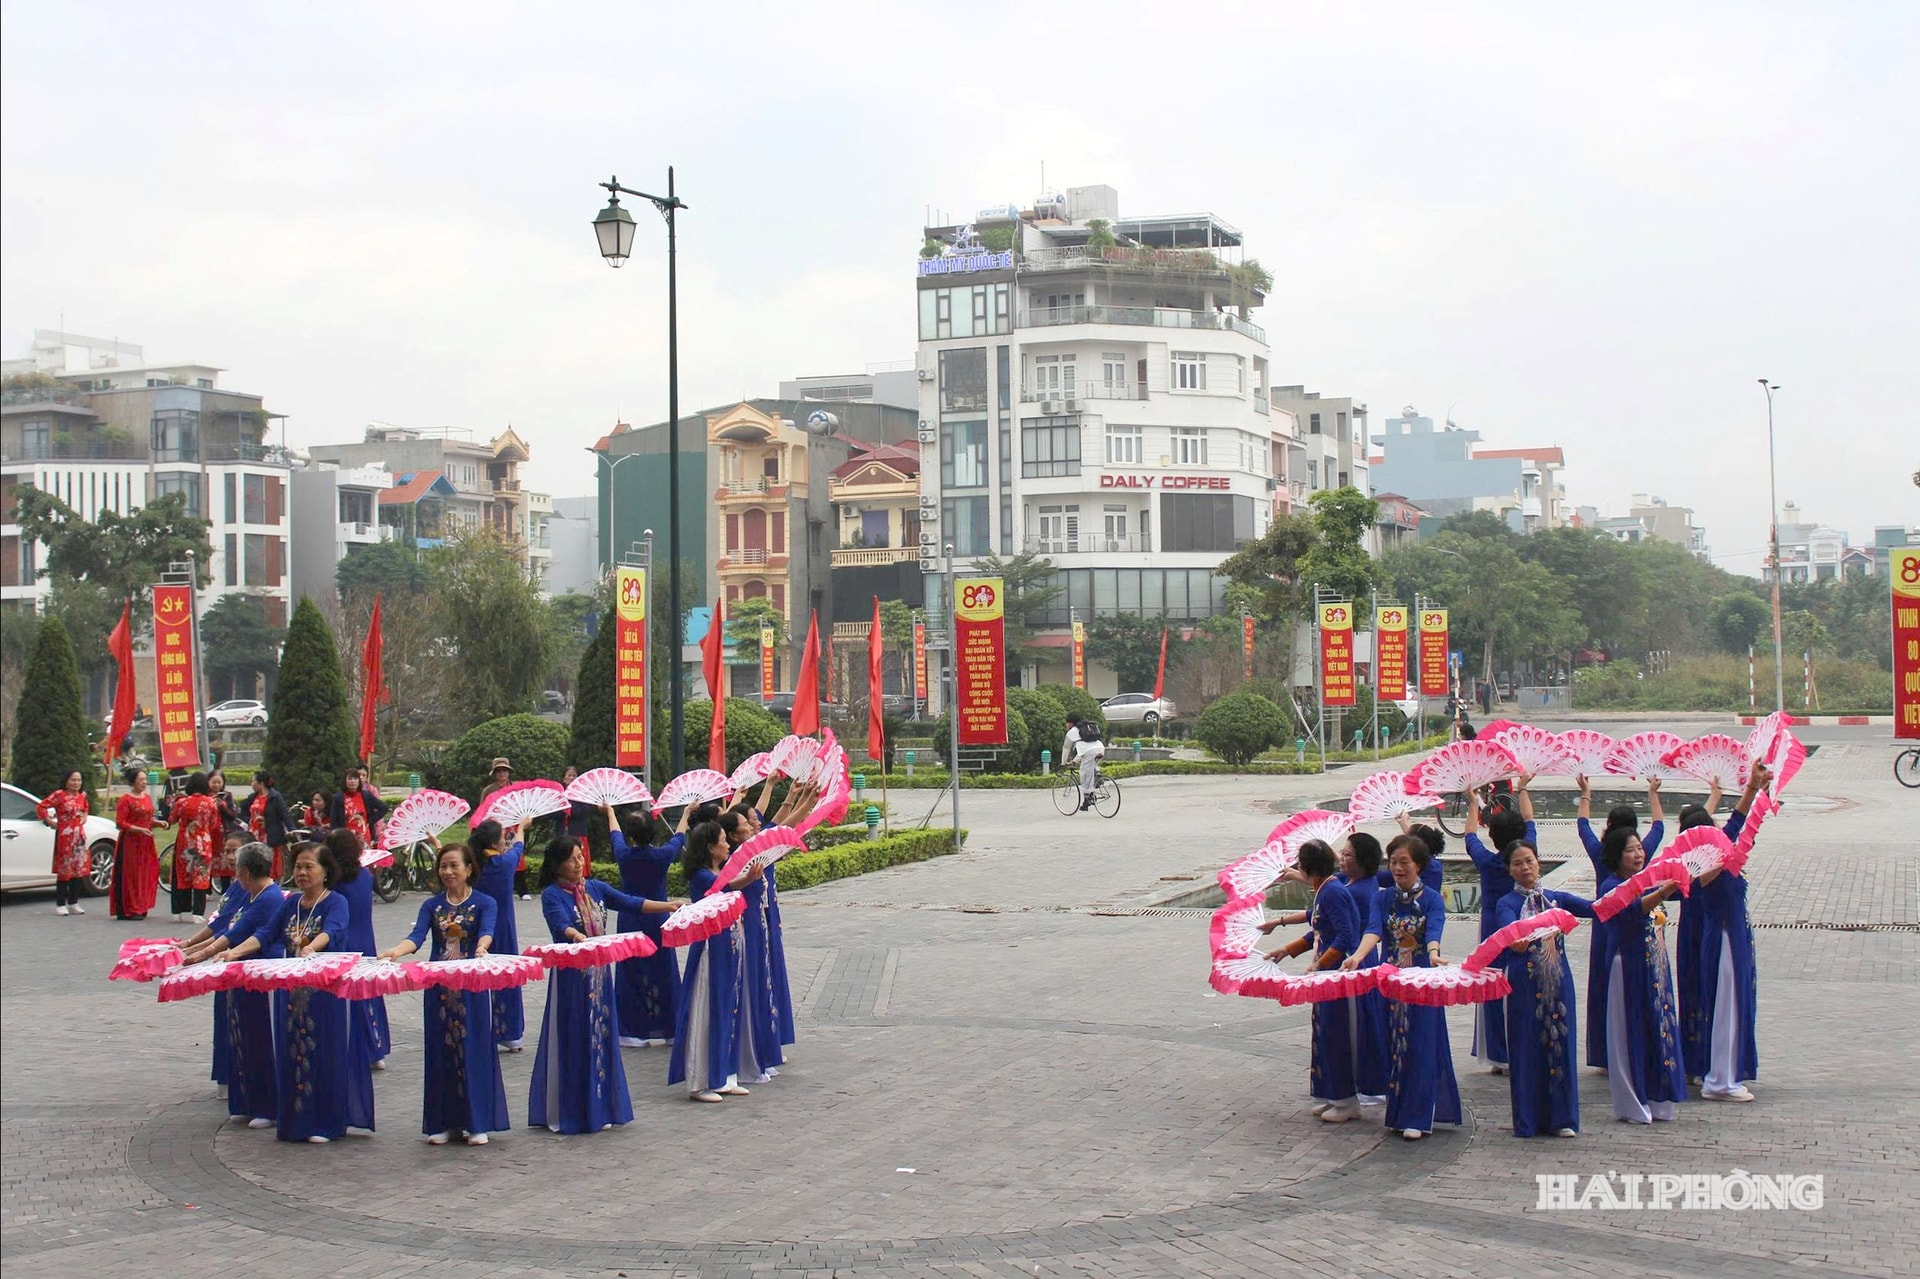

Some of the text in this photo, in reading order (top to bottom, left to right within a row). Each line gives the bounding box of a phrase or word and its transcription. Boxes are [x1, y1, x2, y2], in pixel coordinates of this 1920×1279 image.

[968, 249, 996, 272] QUỐC
[999, 248, 1012, 268] TẾ
[1100, 475, 1230, 489] DAILY COFFEE
[963, 585, 995, 608] 80
[1325, 608, 1346, 622] 80
[1897, 608, 1918, 628] VINH
[1907, 640, 1918, 661] 80
